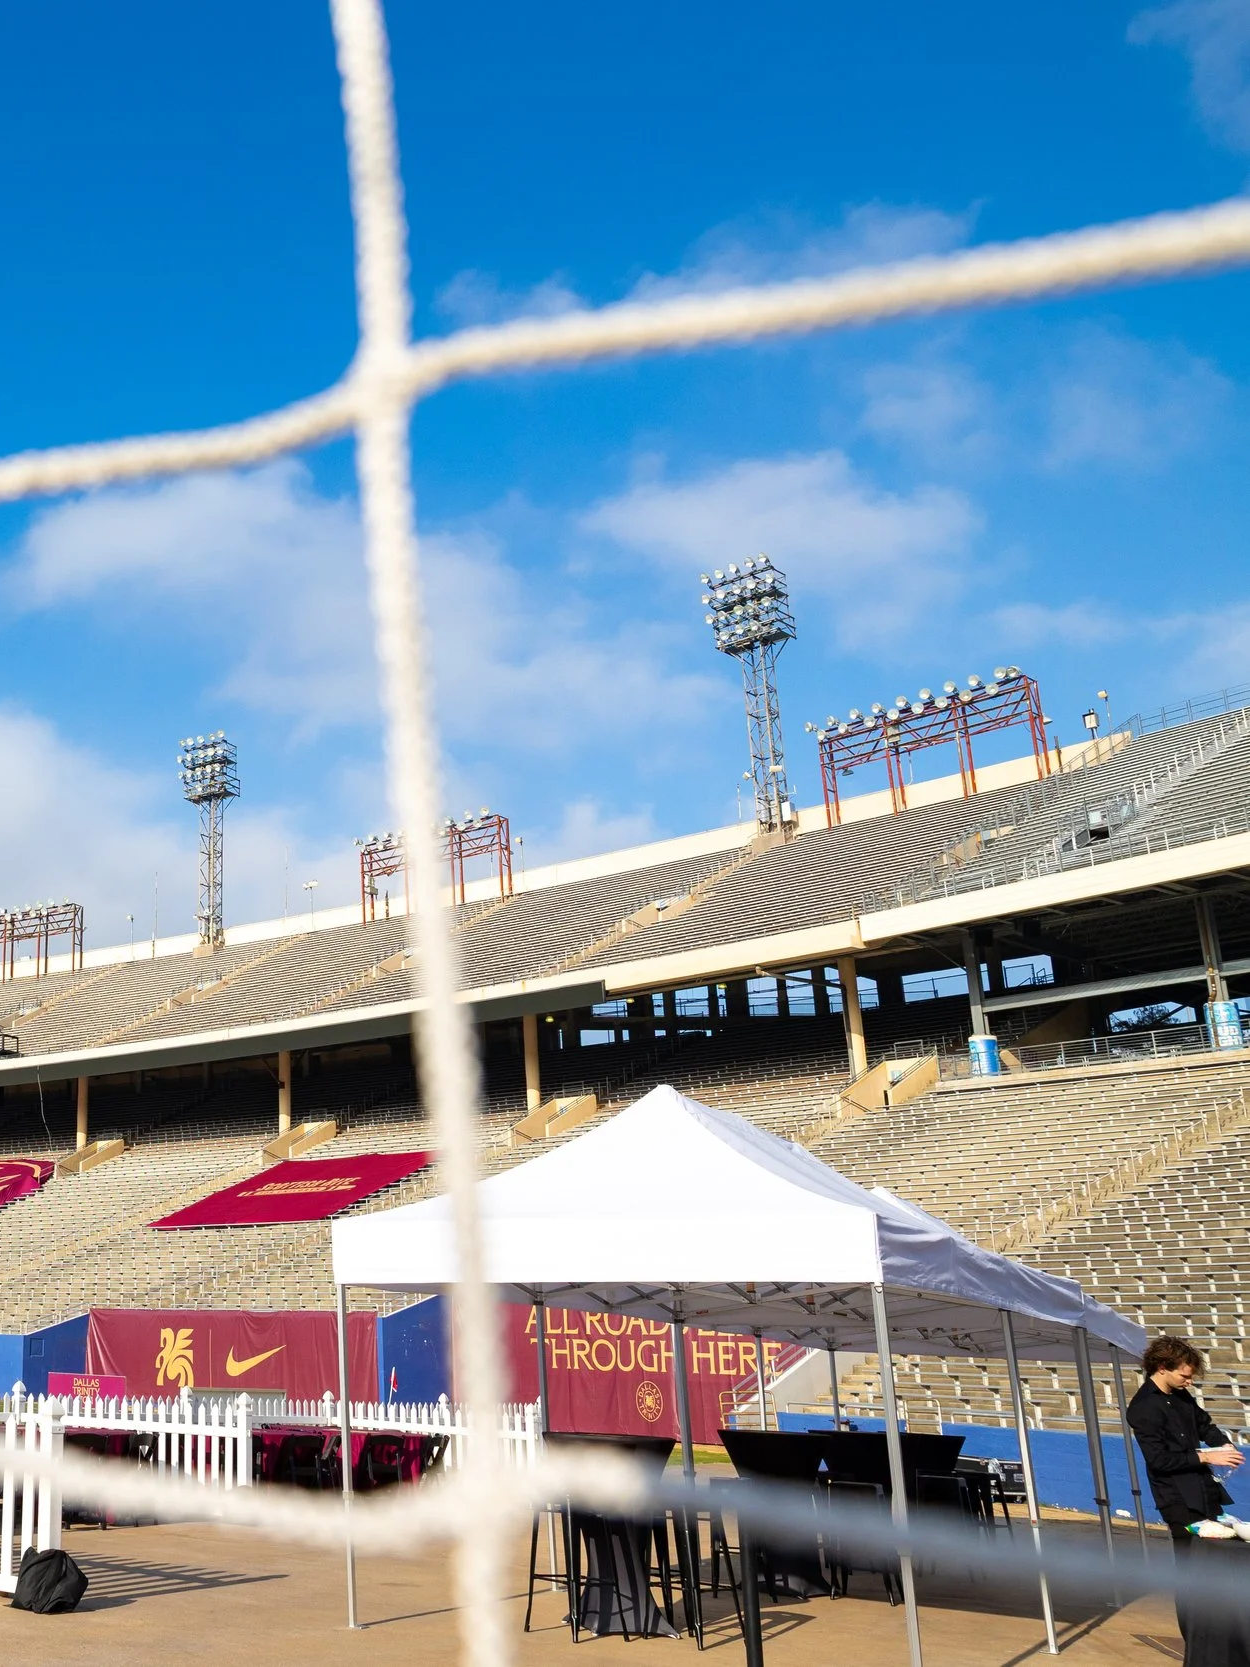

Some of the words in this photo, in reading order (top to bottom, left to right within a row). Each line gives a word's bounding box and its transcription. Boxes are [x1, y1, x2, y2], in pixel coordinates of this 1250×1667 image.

[525, 1304, 579, 1335] ALL
[585, 1311, 688, 1336] ROAD
[691, 1340, 784, 1377] HERE
[73, 1378, 100, 1387] DALLAS
[72, 1386, 100, 1395] TRINITY
[638, 1384, 660, 1399] DALLAS
[639, 1404, 661, 1420] TRINITY
